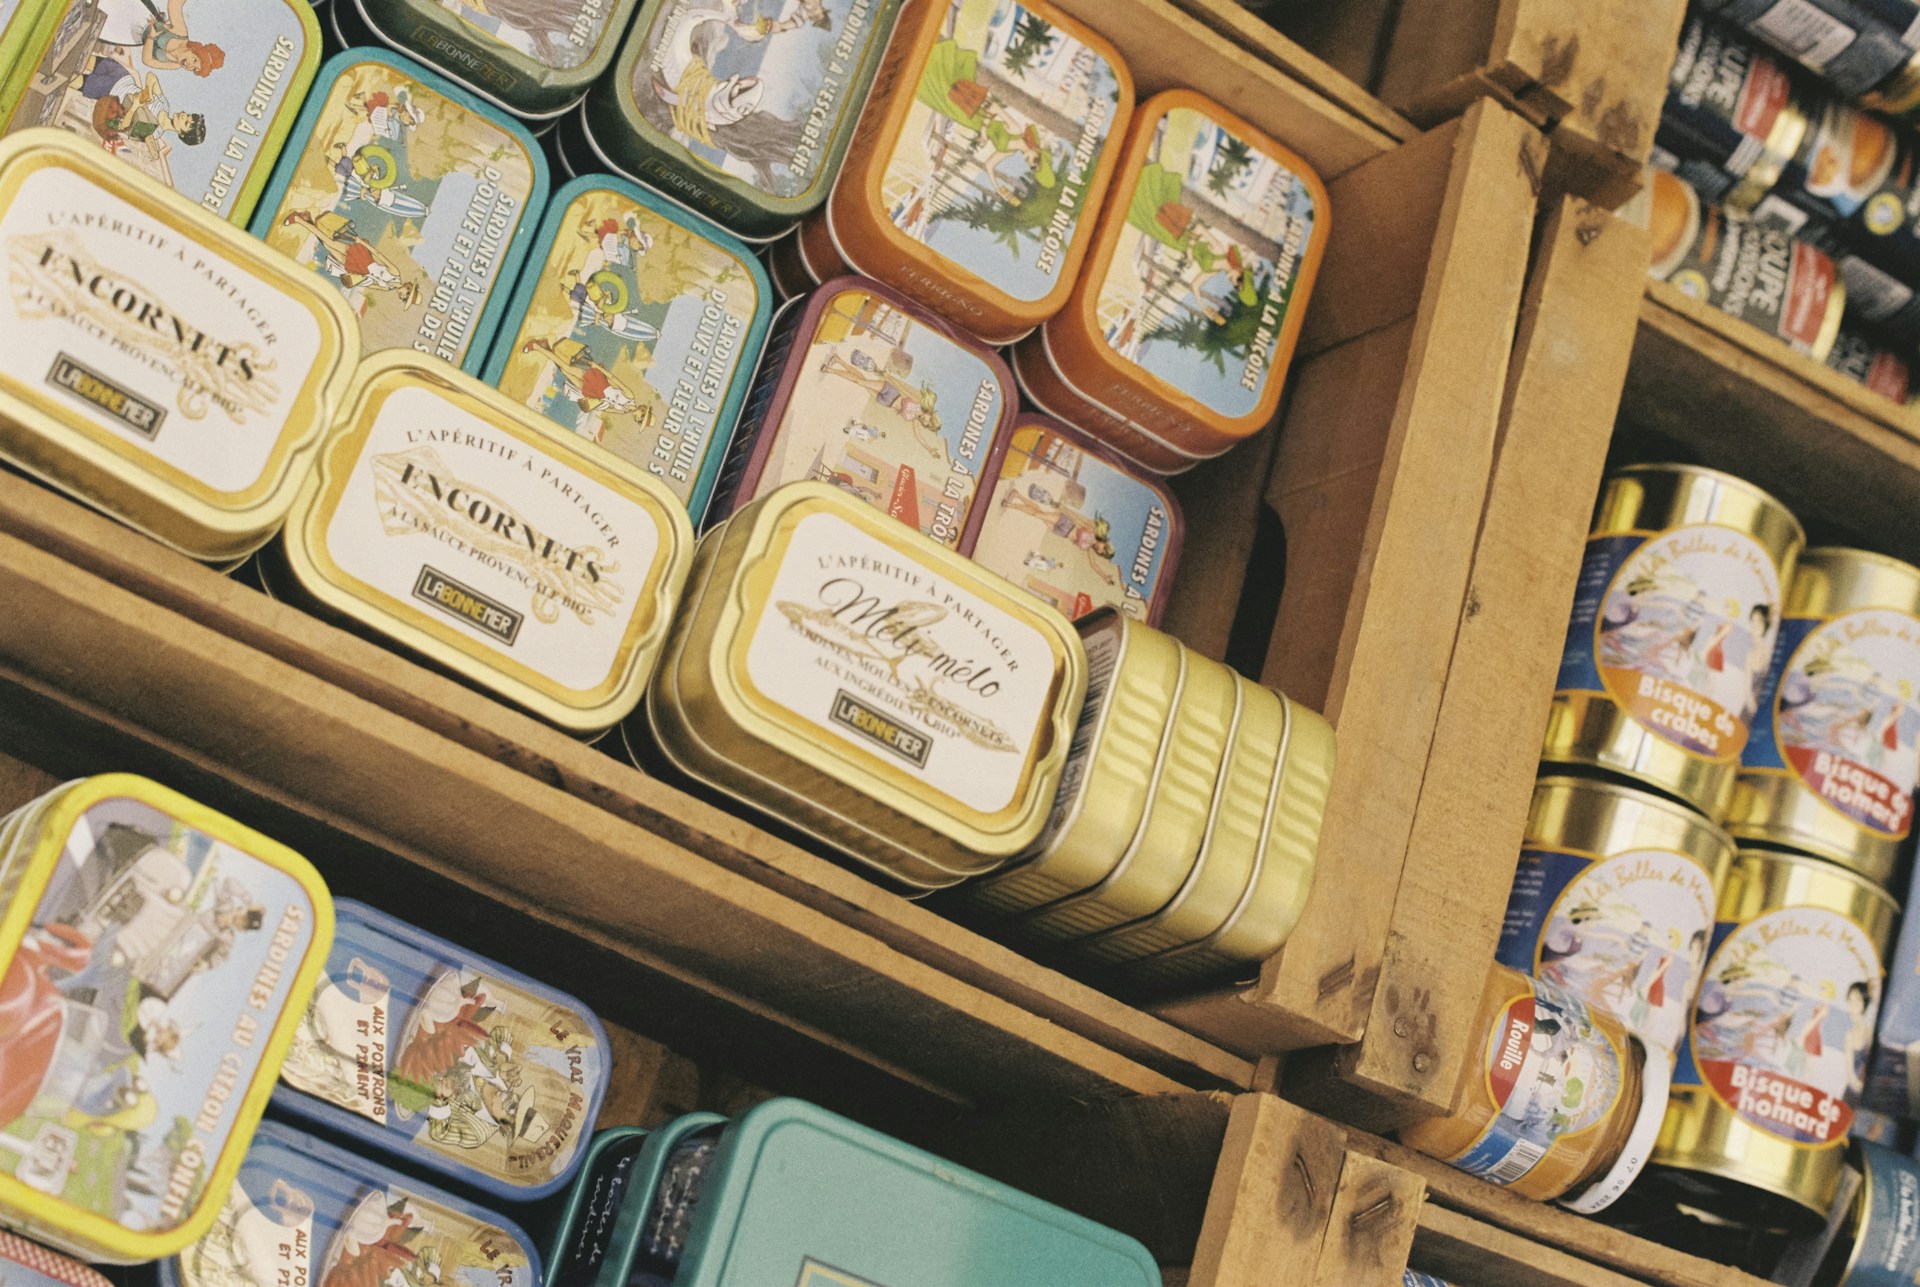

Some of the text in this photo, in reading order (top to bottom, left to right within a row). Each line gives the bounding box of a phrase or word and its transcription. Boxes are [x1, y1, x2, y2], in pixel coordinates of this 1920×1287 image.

[245, 35, 295, 120] SARDINES
[225, 136, 249, 161] LA
[237, 118, 260, 137] À
[790, 76, 838, 177] L'ESCABÈCHE
[1073, 97, 1108, 171] SARDINES
[462, 165, 501, 234] D'OLIVE
[1059, 186, 1078, 208] LA
[452, 233, 474, 258] ET
[1036, 208, 1071, 275] NIÇOISE
[1269, 216, 1301, 289] SARDINES
[193, 260, 278, 346] PARTAGER
[430, 257, 464, 314] FLEUR
[435, 192, 515, 362] SARDINES À L'HUILE
[39, 246, 257, 381] ENCORNETS
[419, 312, 442, 340] DE
[691, 288, 728, 355] D'OLIVE
[1261, 302, 1279, 325] LA
[682, 355, 703, 380] ET
[1241, 326, 1275, 392] NIÇOISE
[662, 378, 695, 434] FLEUR
[669, 314, 740, 482] SARDINES À L'HUILE
[959, 378, 996, 460] SARDINES
[654, 434, 675, 460] DE
[953, 459, 972, 475] À
[406, 428, 518, 461] L'APÉRITIF
[540, 468, 620, 549] PARTAGER
[944, 476, 964, 501] LA
[401, 462, 607, 584] ENCORNETS
[420, 522, 468, 556] SAUCE
[1132, 506, 1164, 585] SARDINES
[818, 553, 920, 587] L'APÉRITIF
[944, 594, 1019, 672] PARTAGER
[814, 655, 842, 678] AUX
[1638, 674, 1735, 737] Bisque de
[1651, 708, 1718, 750] crabes
[1814, 751, 1890, 799] Bisque
[1821, 775, 1901, 832] homard
[161, 904, 305, 1220] SARDINES AU CITRON CONFIT
[355, 1018, 370, 1100] ET PIMENT
[370, 1005, 386, 1117] AUX POIVRONS
[550, 1020, 569, 1041] LE
[565, 1044, 583, 1085] VRAI
[1500, 1018, 1529, 1070] Rouille
[1731, 1064, 1841, 1123] Bisque de
[1738, 1088, 1830, 1139] homard
[1627, 1157, 1638, 1173] 07
[278, 1242, 291, 1260] ET
[296, 1228, 307, 1259] AUX
[480, 1239, 500, 1261] LE
